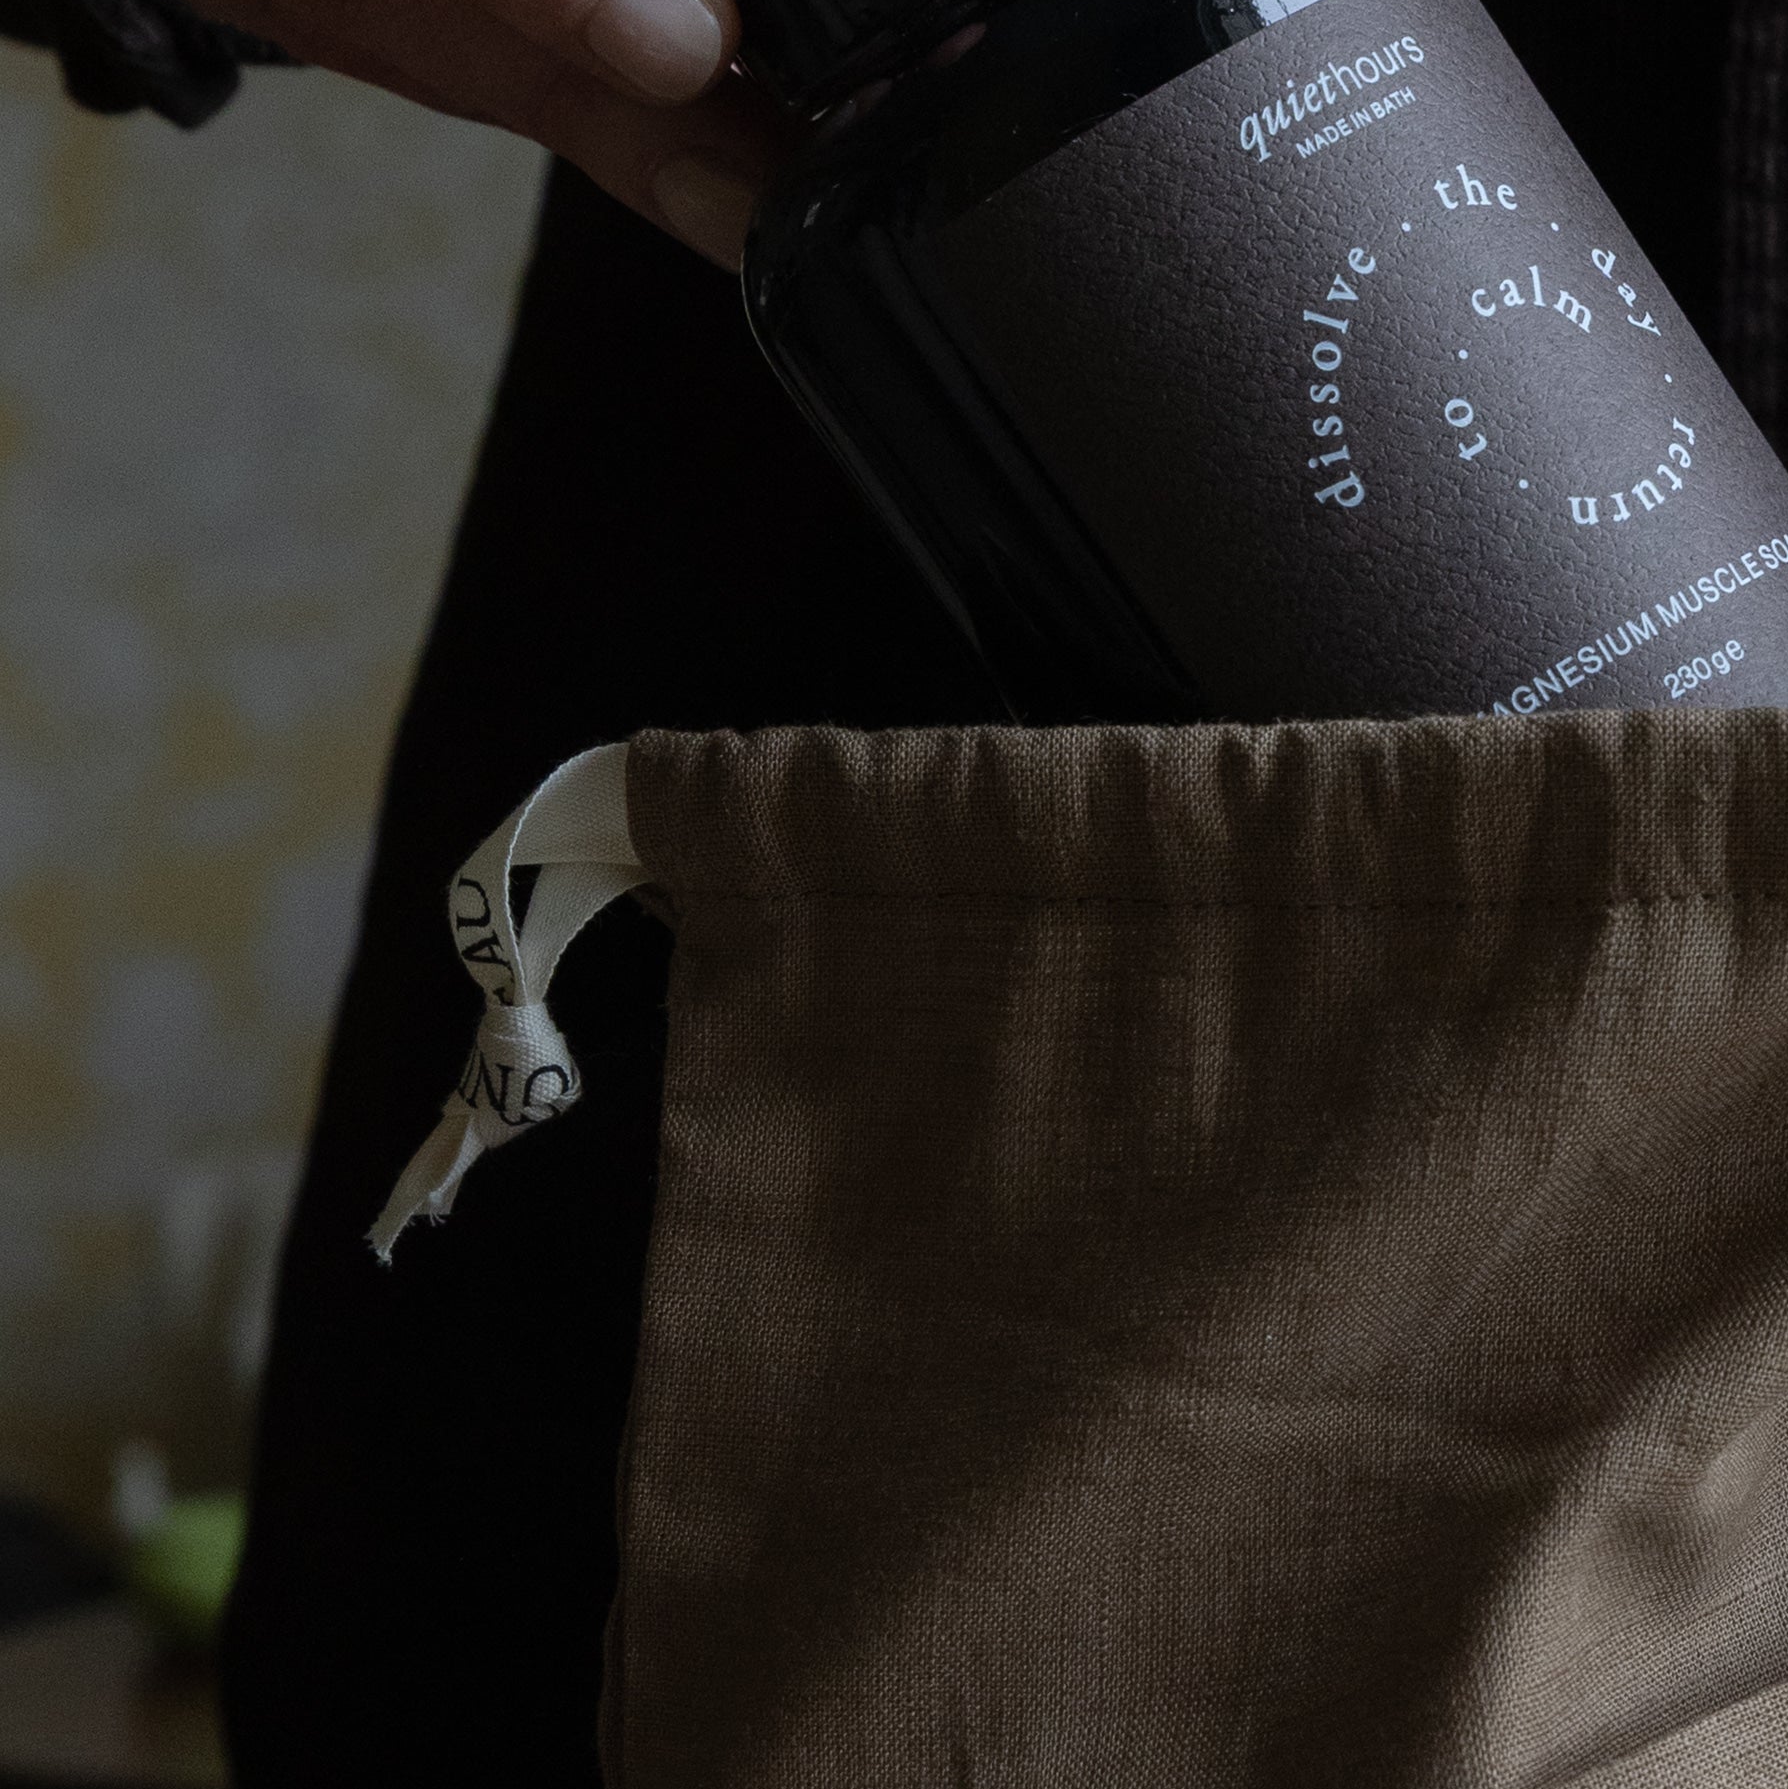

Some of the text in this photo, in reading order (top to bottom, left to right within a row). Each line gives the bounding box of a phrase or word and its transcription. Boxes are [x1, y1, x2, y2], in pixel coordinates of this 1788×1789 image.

[1296, 86, 1416, 159] MADE IN BATH
[1303, 164, 1696, 526] dissolve the day return to calm
[1477, 612, 1658, 719] AGNESIUM
[1655, 552, 1764, 627] MUSCLE
